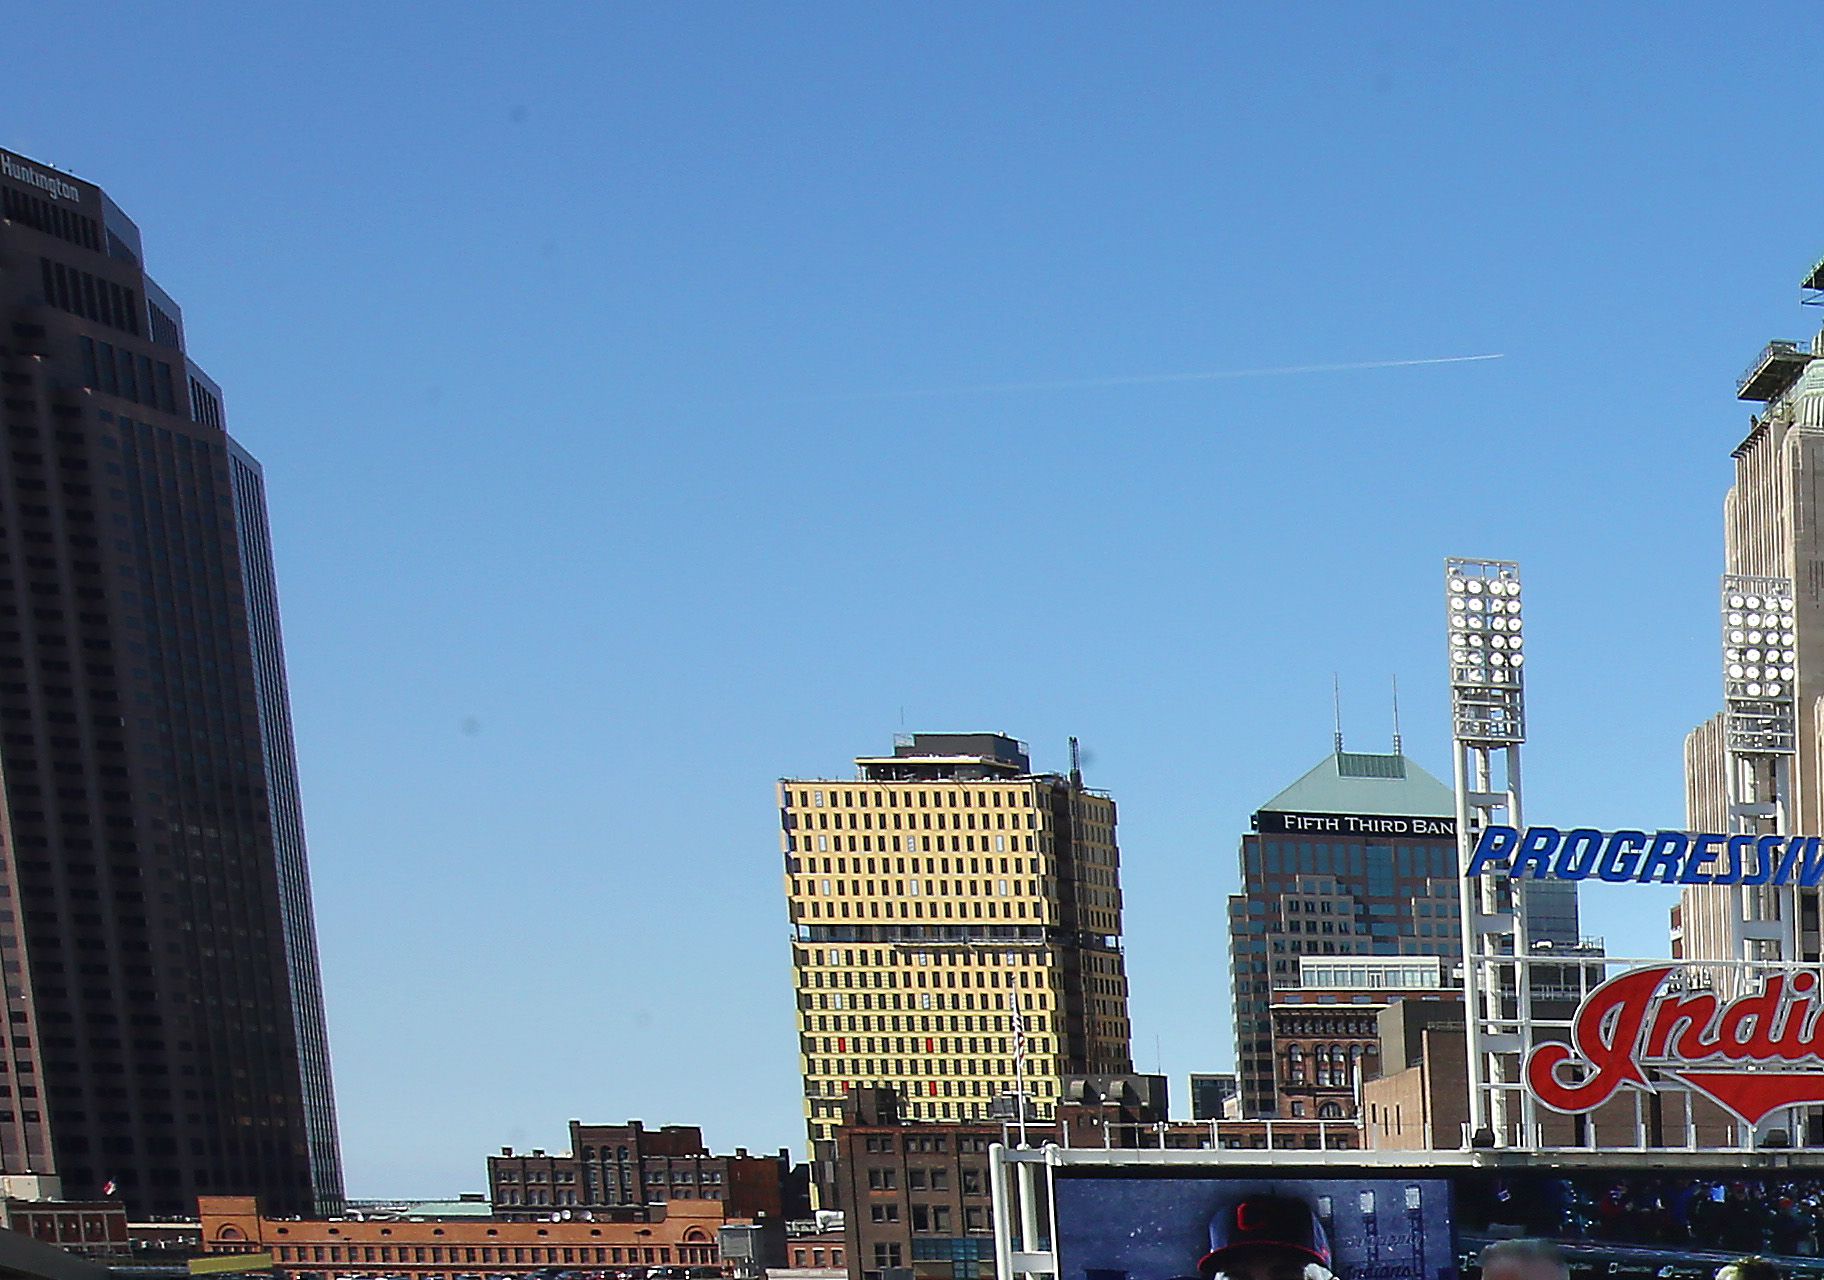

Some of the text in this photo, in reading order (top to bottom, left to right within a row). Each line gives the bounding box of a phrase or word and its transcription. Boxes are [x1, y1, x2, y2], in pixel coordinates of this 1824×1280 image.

[1284, 815, 1458, 835] FIFTH THIRD BAN
